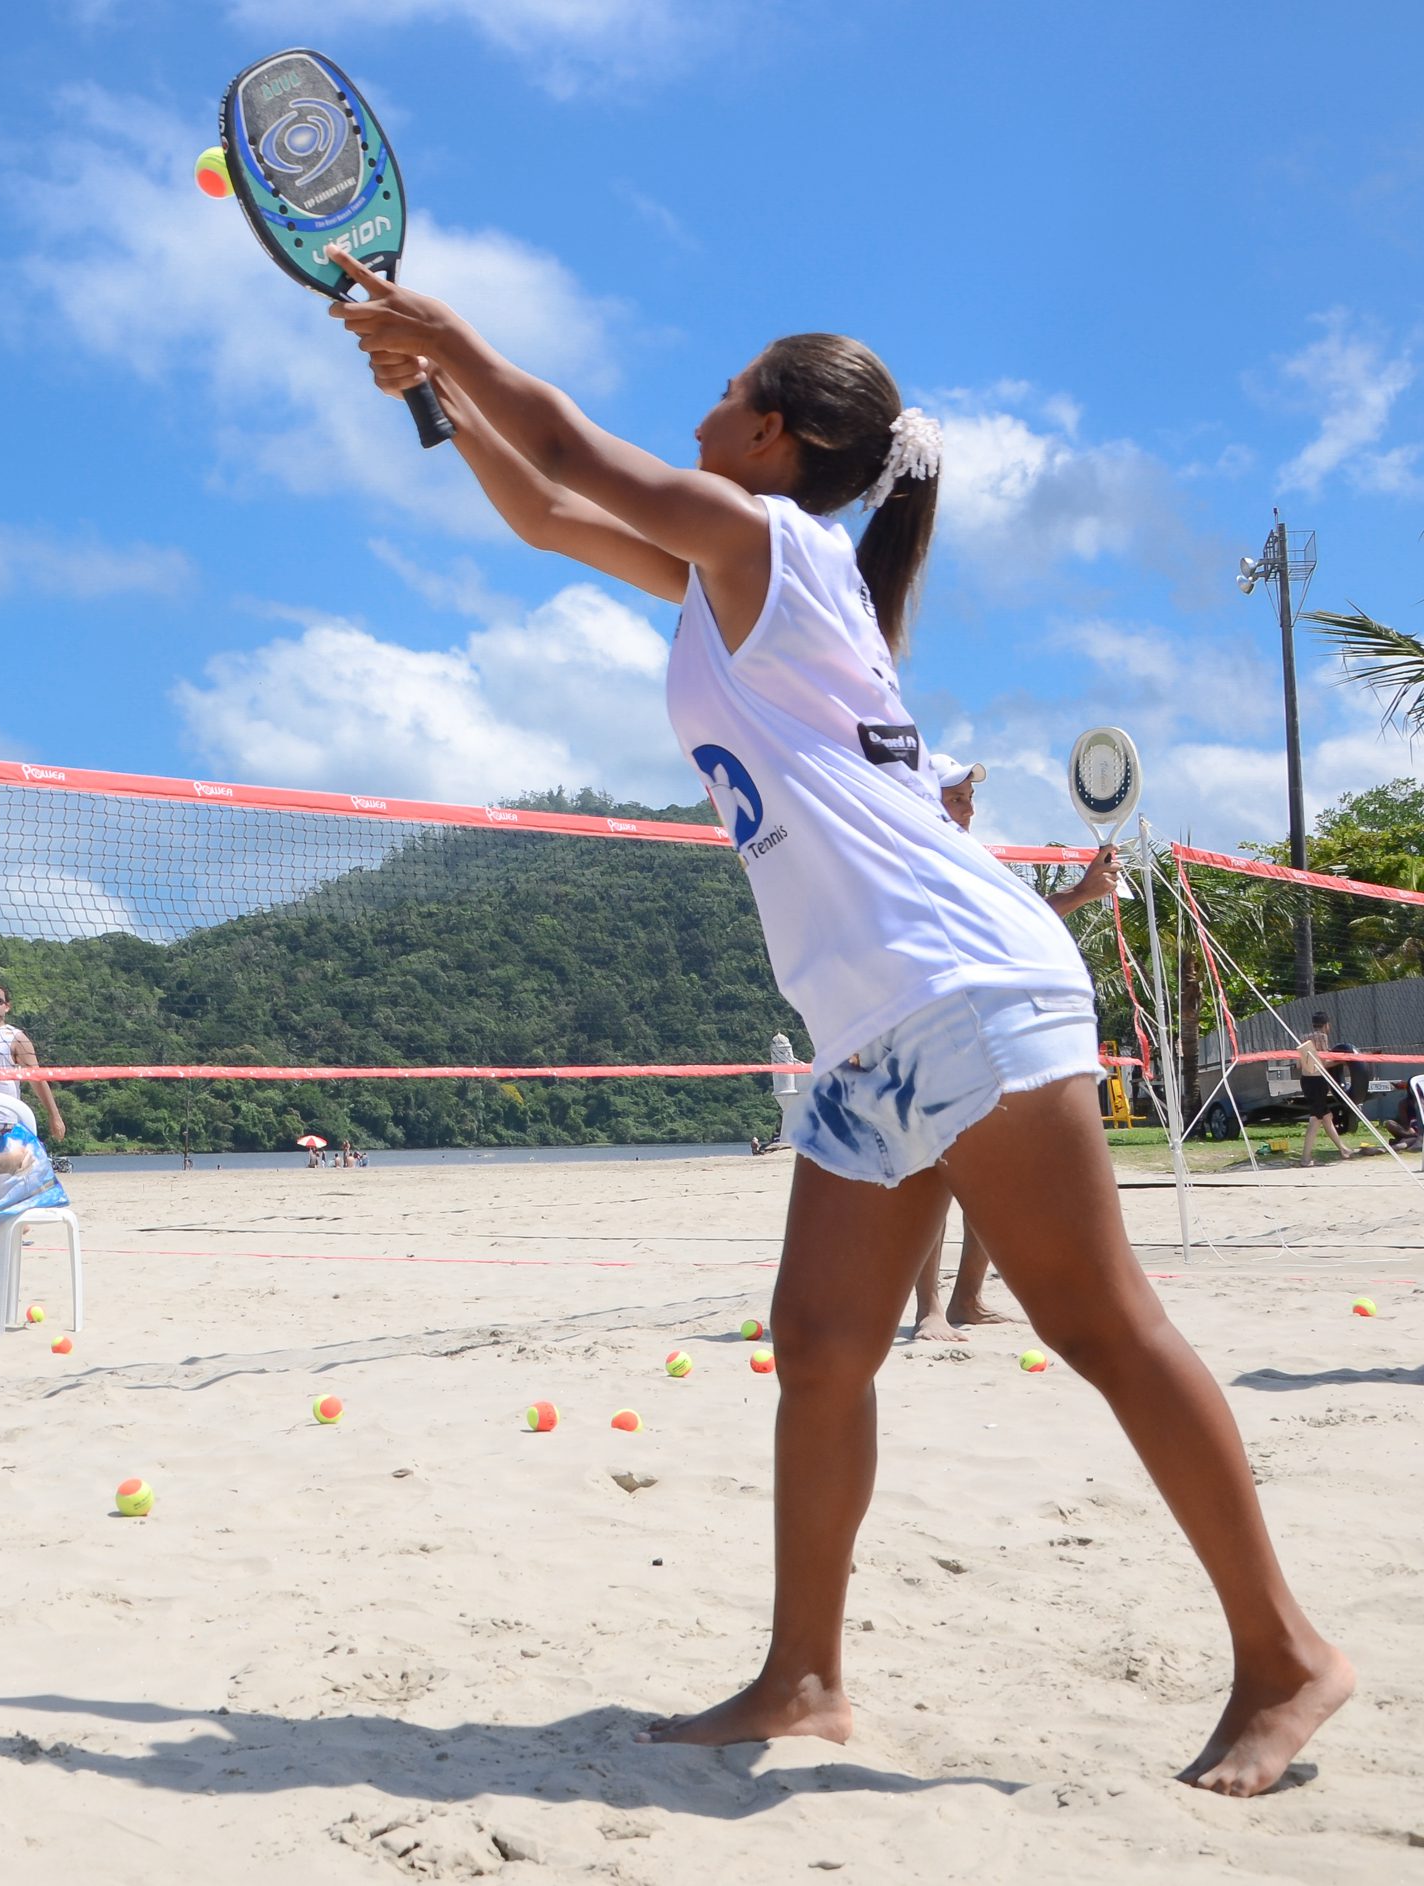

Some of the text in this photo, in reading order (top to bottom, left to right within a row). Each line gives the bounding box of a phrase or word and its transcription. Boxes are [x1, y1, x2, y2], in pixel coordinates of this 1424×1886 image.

[21, 763, 66, 781] POWER
[193, 781, 232, 796] POWER
[350, 795, 387, 810] POWER
[485, 806, 518, 822] POWER
[607, 818, 637, 832] POWER
[747, 825, 788, 859] Tennis
